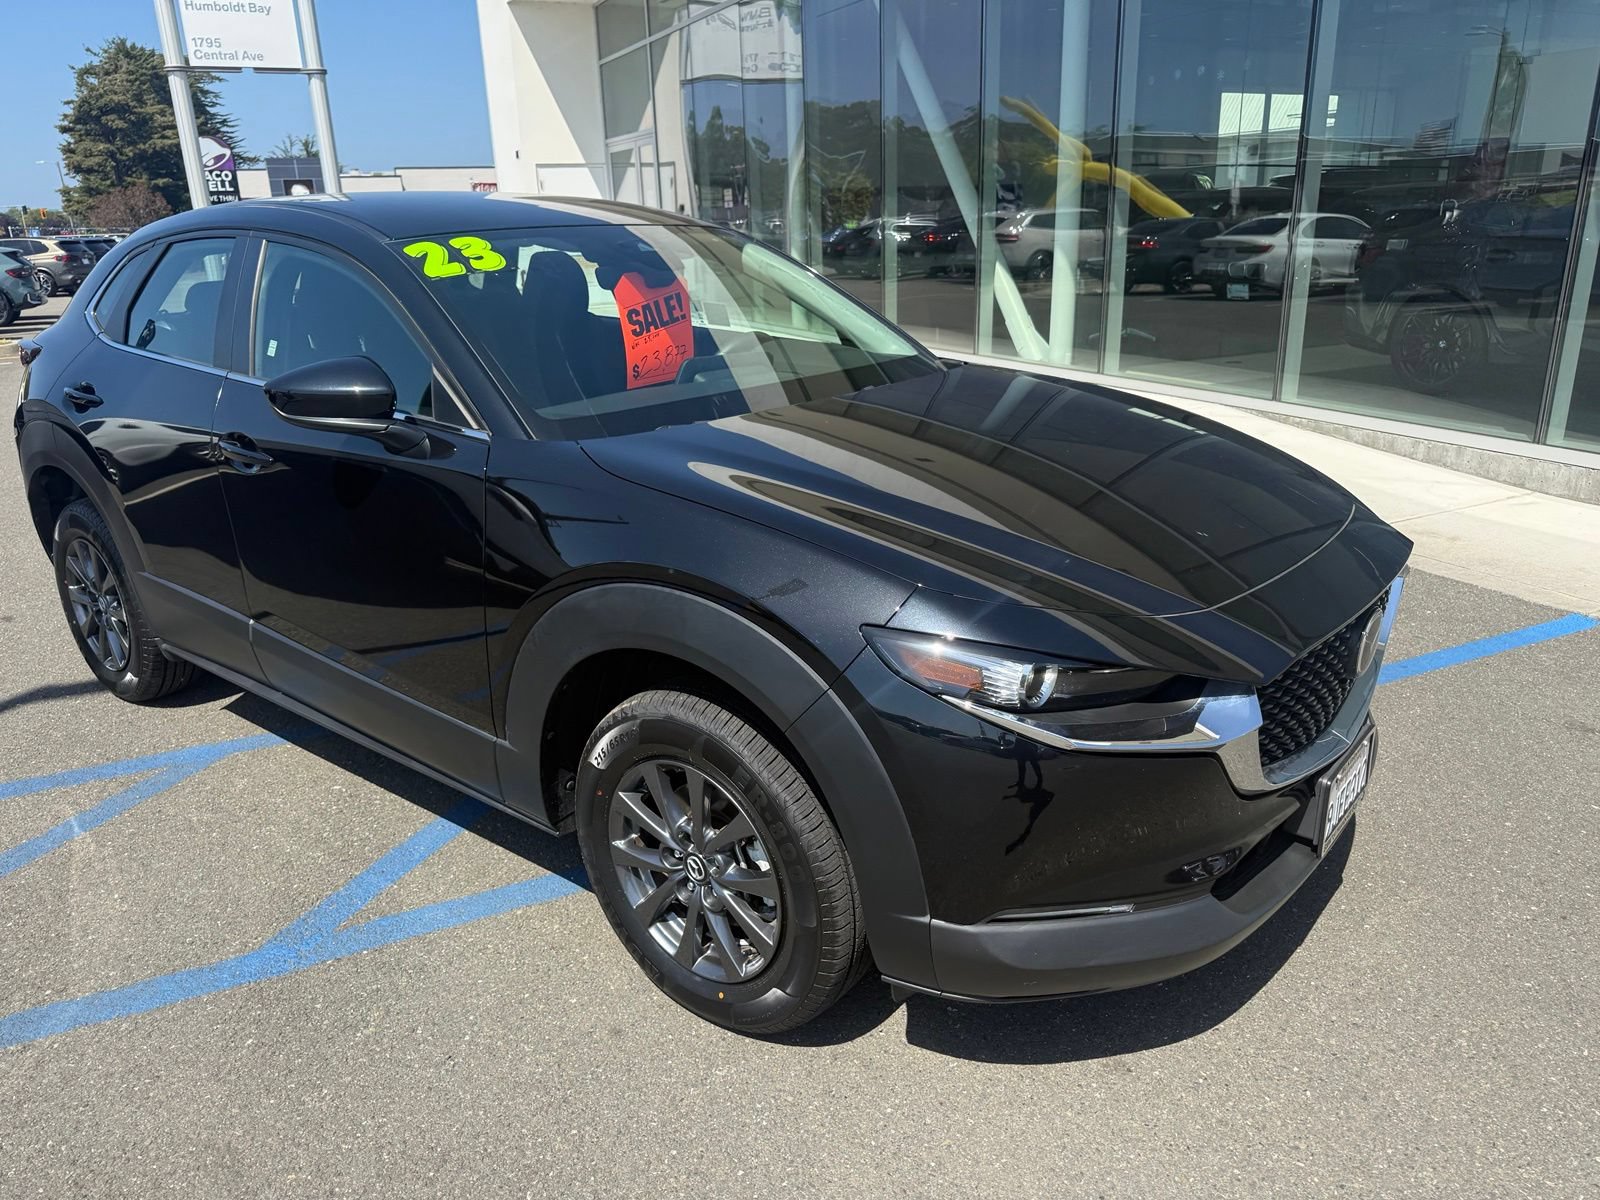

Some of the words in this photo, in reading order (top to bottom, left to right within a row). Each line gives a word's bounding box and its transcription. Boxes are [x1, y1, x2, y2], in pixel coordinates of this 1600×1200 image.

[184, 1, 246, 13] Humboldt
[248, 2, 272, 16] Bay
[191, 37, 222, 49] 1795
[193, 49, 238, 61] Central
[241, 51, 264, 62] Ave
[205, 170, 233, 182] ACO
[208, 180, 235, 192] ELL
[402, 236, 507, 278] 23
[626, 293, 688, 338] SALE!
